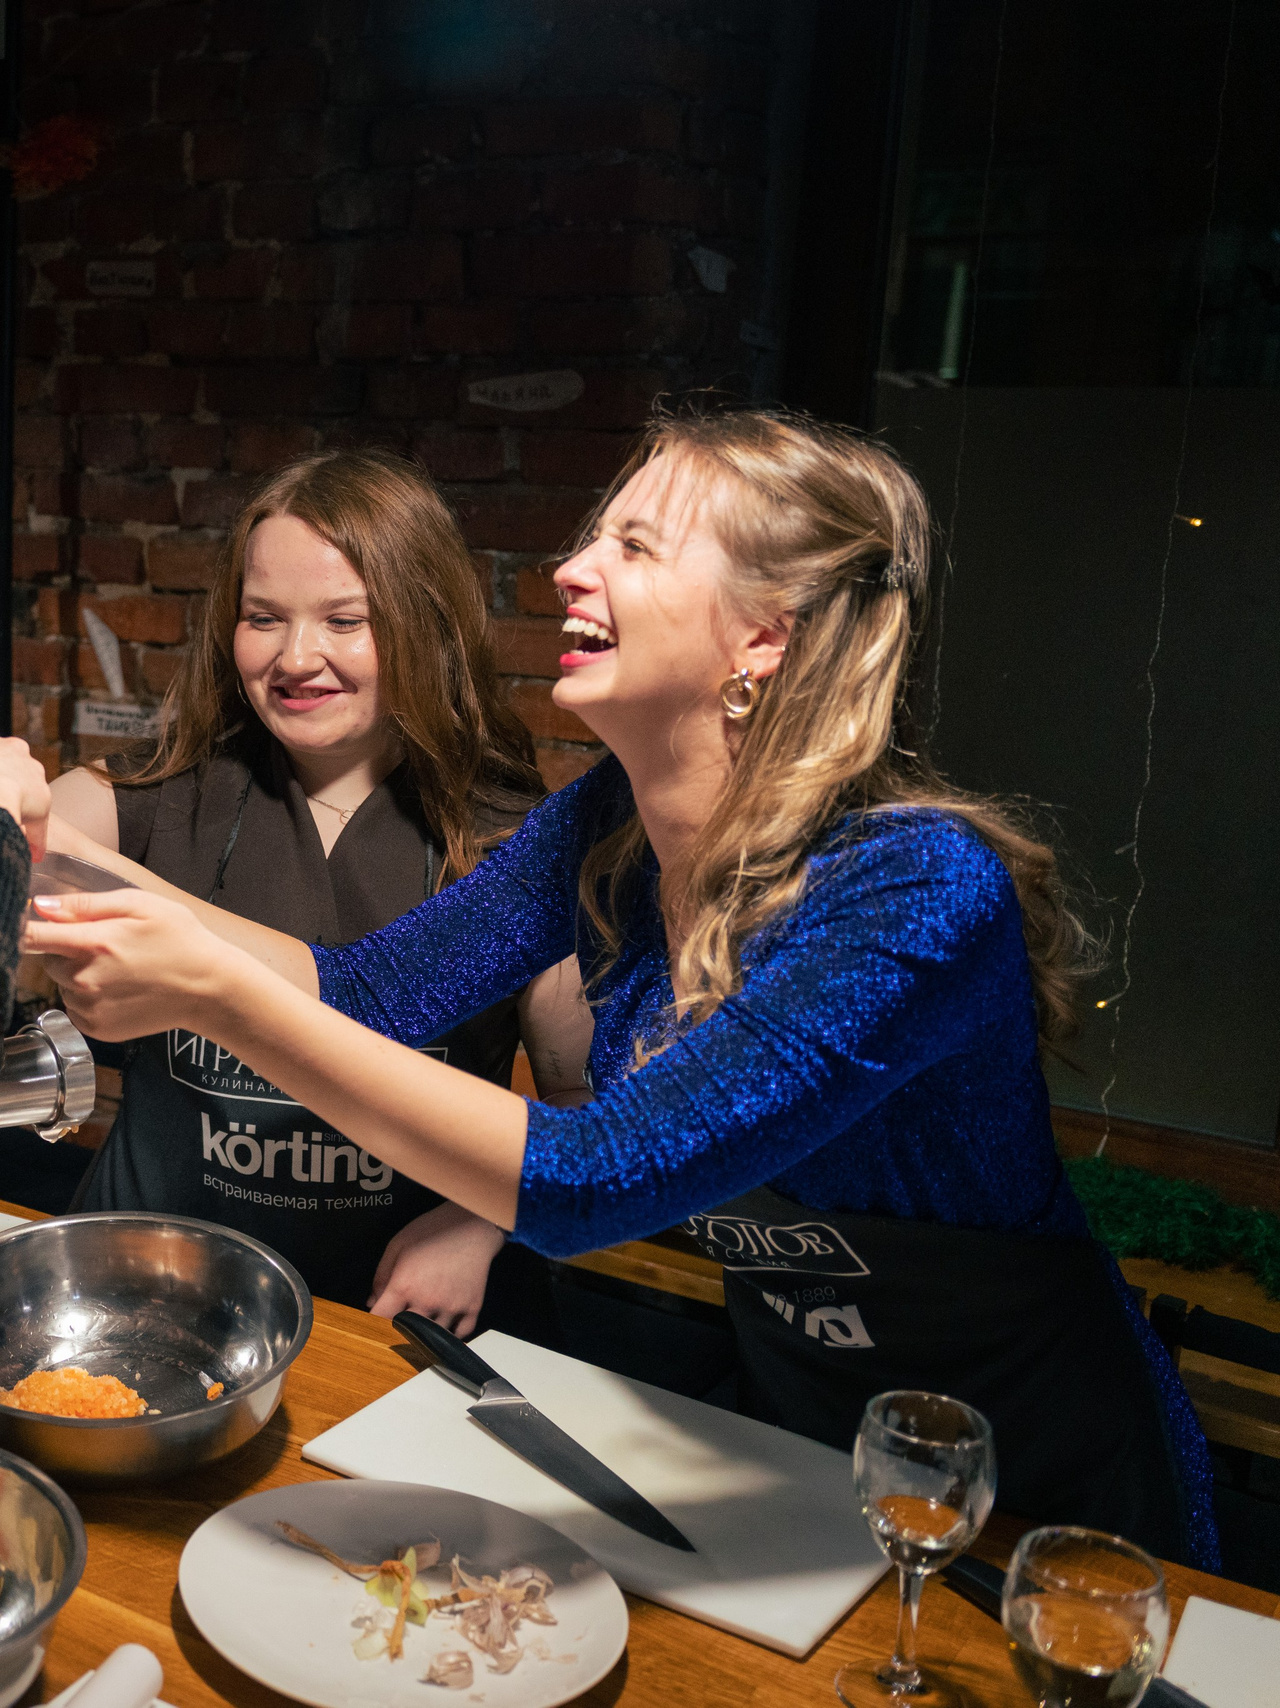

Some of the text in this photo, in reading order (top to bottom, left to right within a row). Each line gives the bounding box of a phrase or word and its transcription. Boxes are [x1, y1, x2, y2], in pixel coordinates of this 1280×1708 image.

[202, 1074, 284, 1094] КУЛИНАР
[324, 1132, 351, 1143] sinc
[201, 1111, 394, 1191] körting
[203, 1173, 393, 1211] встраиваемая техника
[792, 1286, 837, 1304] 1889
